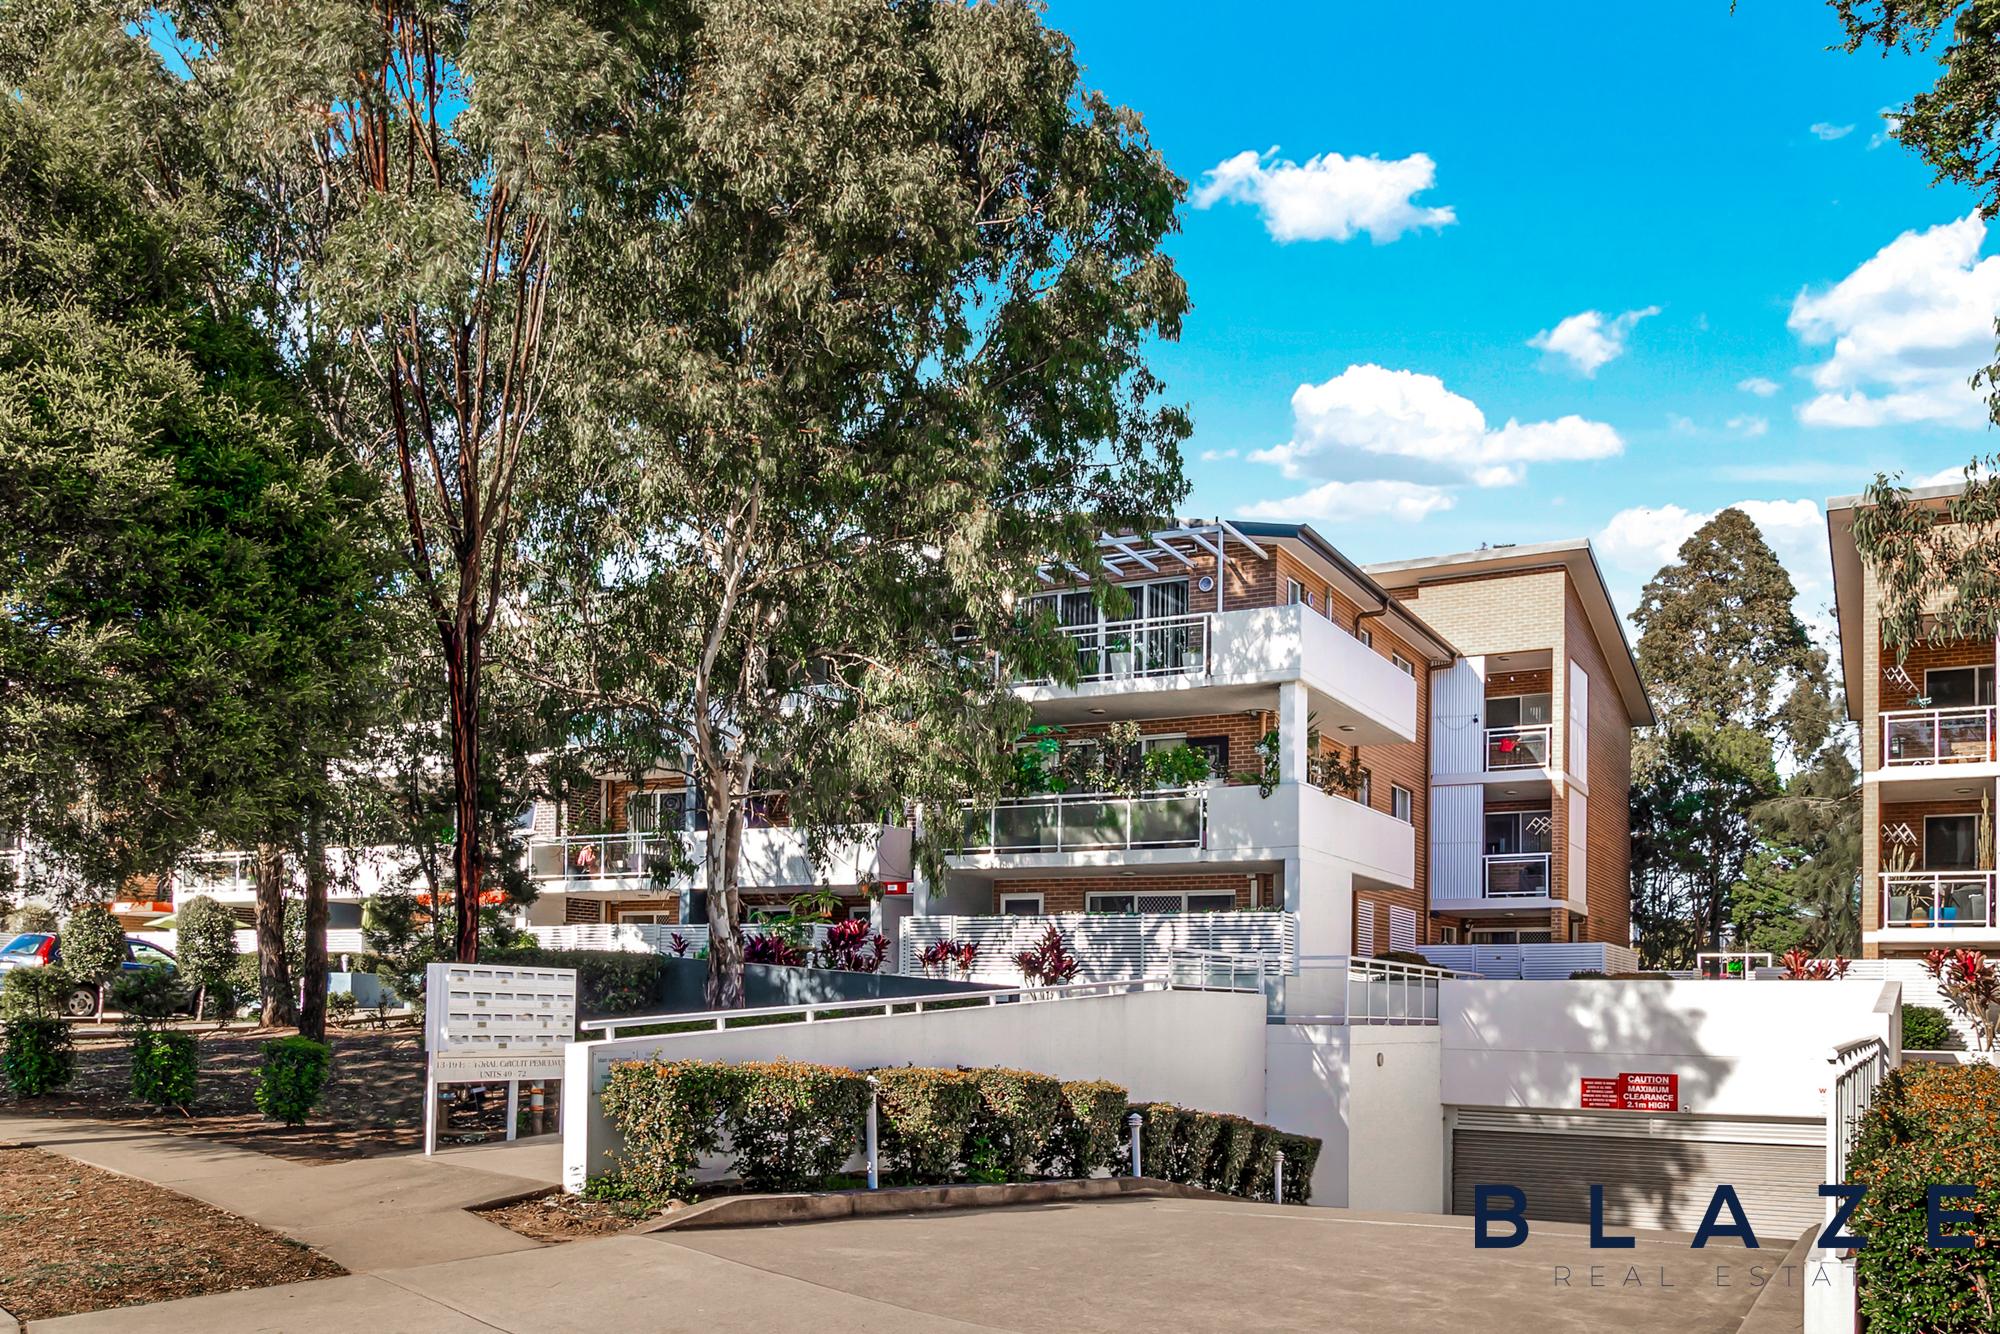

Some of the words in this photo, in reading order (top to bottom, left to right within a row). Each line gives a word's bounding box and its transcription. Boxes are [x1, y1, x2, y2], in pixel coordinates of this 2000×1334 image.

[529, 1059, 565, 1067] PEMULWU
[1627, 1075, 1669, 1084] CAUTION
[1627, 1085, 1669, 1093] MAXIMUM
[1623, 1093, 1674, 1102] CLEARANCE
[1648, 1101, 1669, 1109] HIGH
